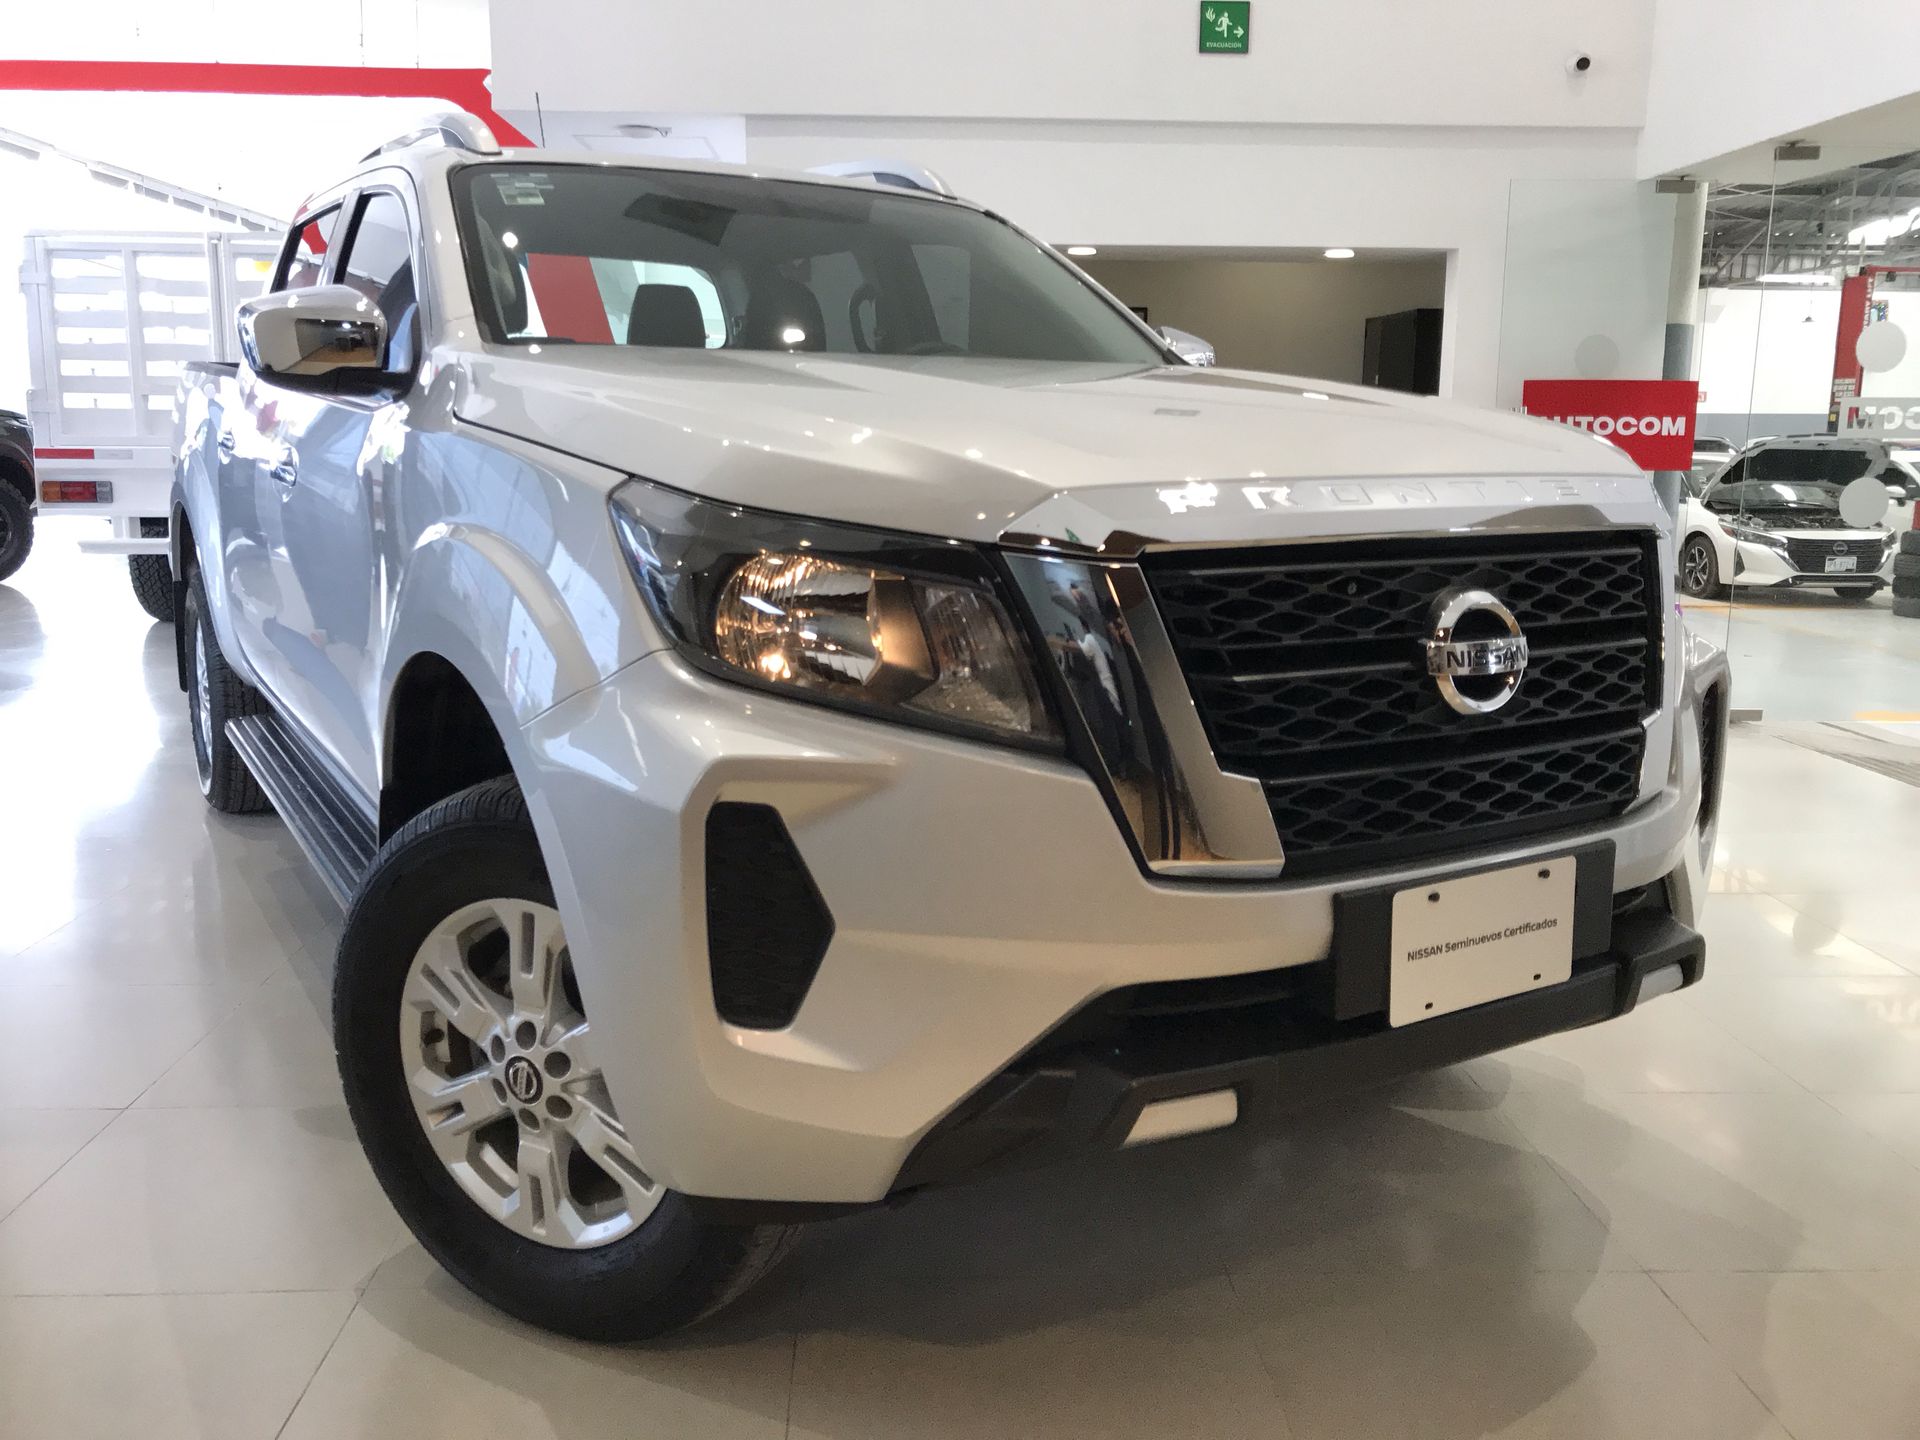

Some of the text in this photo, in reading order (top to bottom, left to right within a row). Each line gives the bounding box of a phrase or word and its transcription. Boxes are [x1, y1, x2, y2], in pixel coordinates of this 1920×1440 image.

[1539, 415, 1687, 436] TOCOM
[1446, 644, 1527, 669] NISSAN
[1407, 917, 1558, 962] NISSAN Seminuevos Certificados
